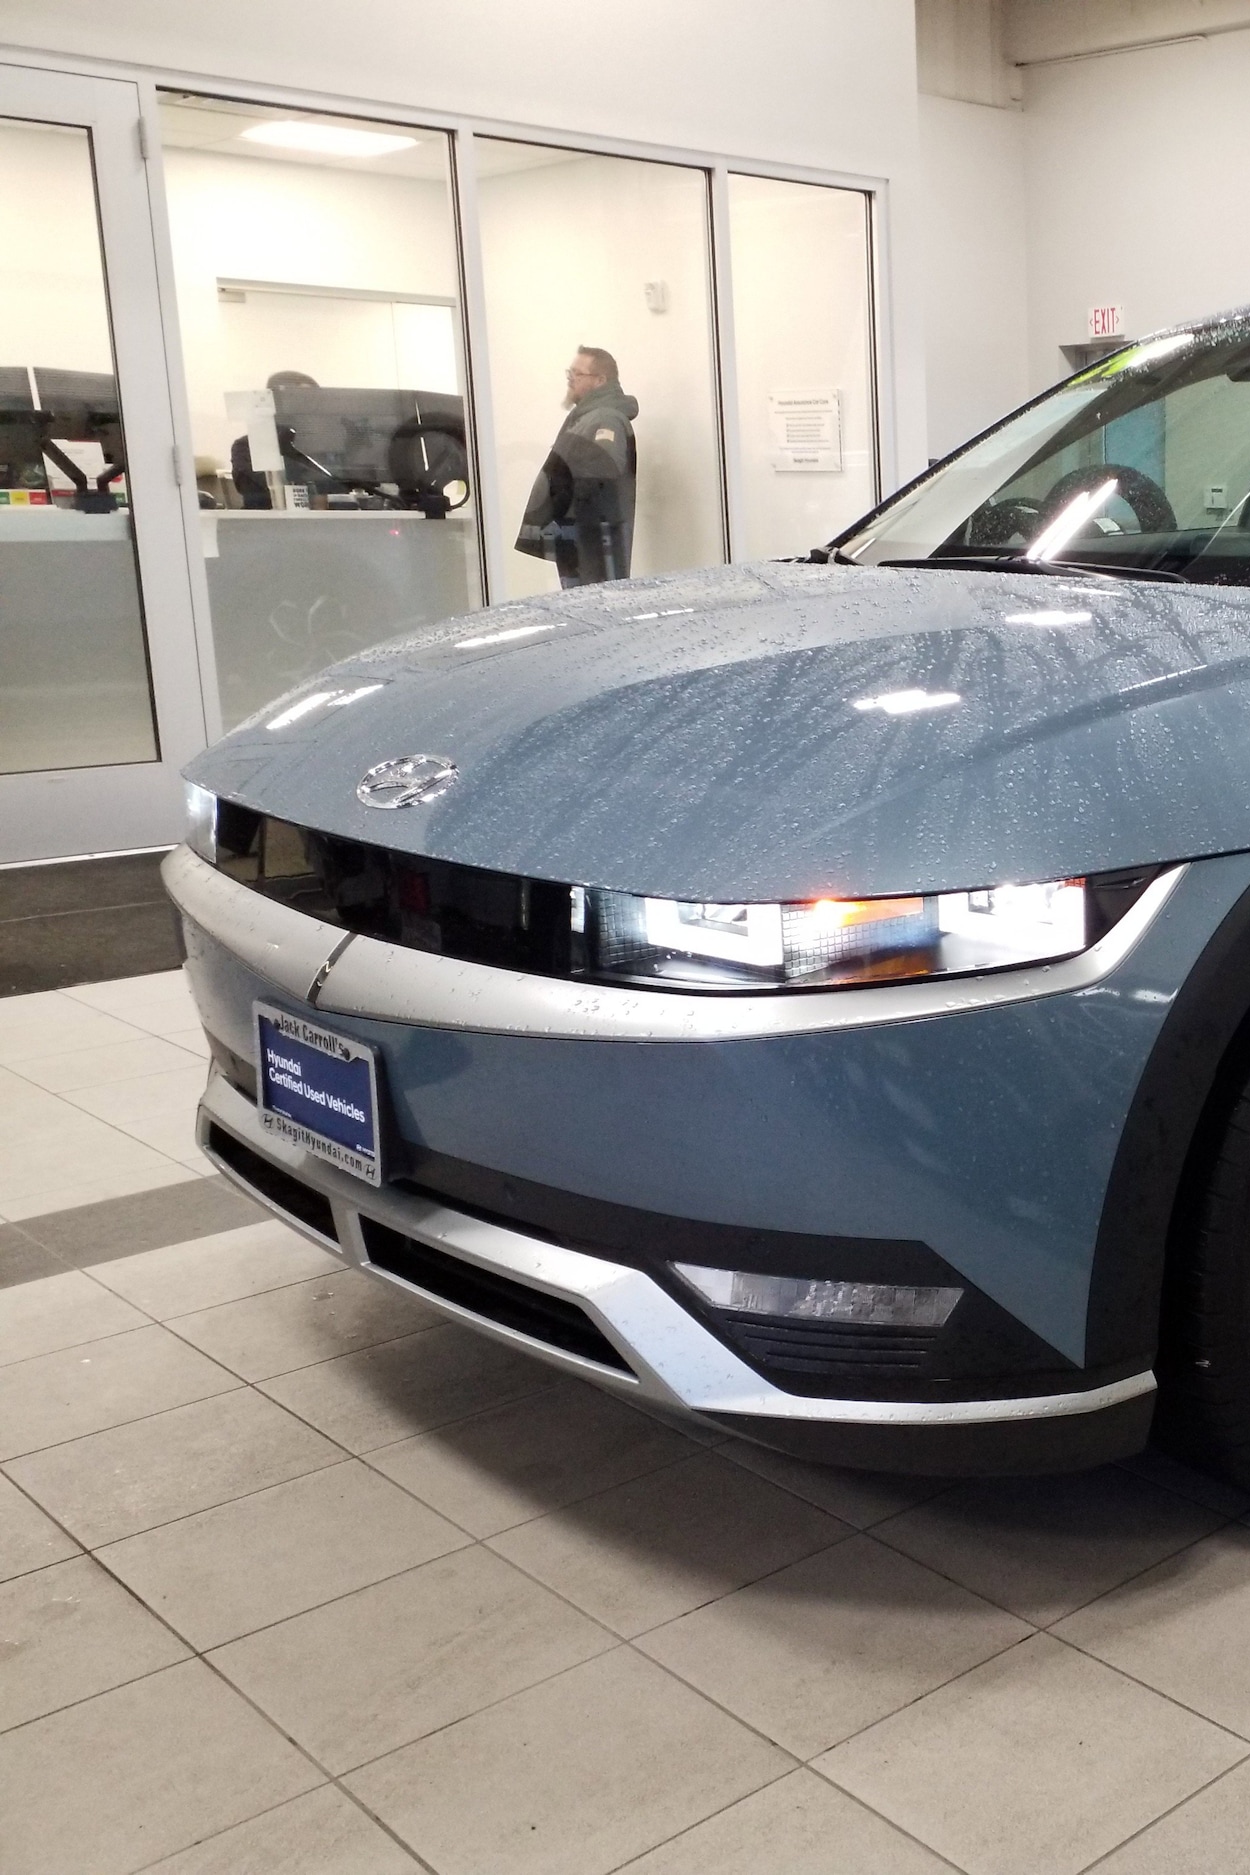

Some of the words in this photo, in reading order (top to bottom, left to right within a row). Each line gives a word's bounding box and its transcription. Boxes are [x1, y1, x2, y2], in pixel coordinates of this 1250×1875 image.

[1093, 307, 1116, 335] EXIT
[280, 1014, 300, 1038] Jack
[302, 1024, 346, 1056] Carroll's
[267, 1048, 302, 1076] Hyundai
[268, 1067, 303, 1095] Certified
[303, 1082, 326, 1106] Used
[325, 1093, 366, 1123] Vehicles
[276, 1117, 363, 1172] SkagitHyundai.com
